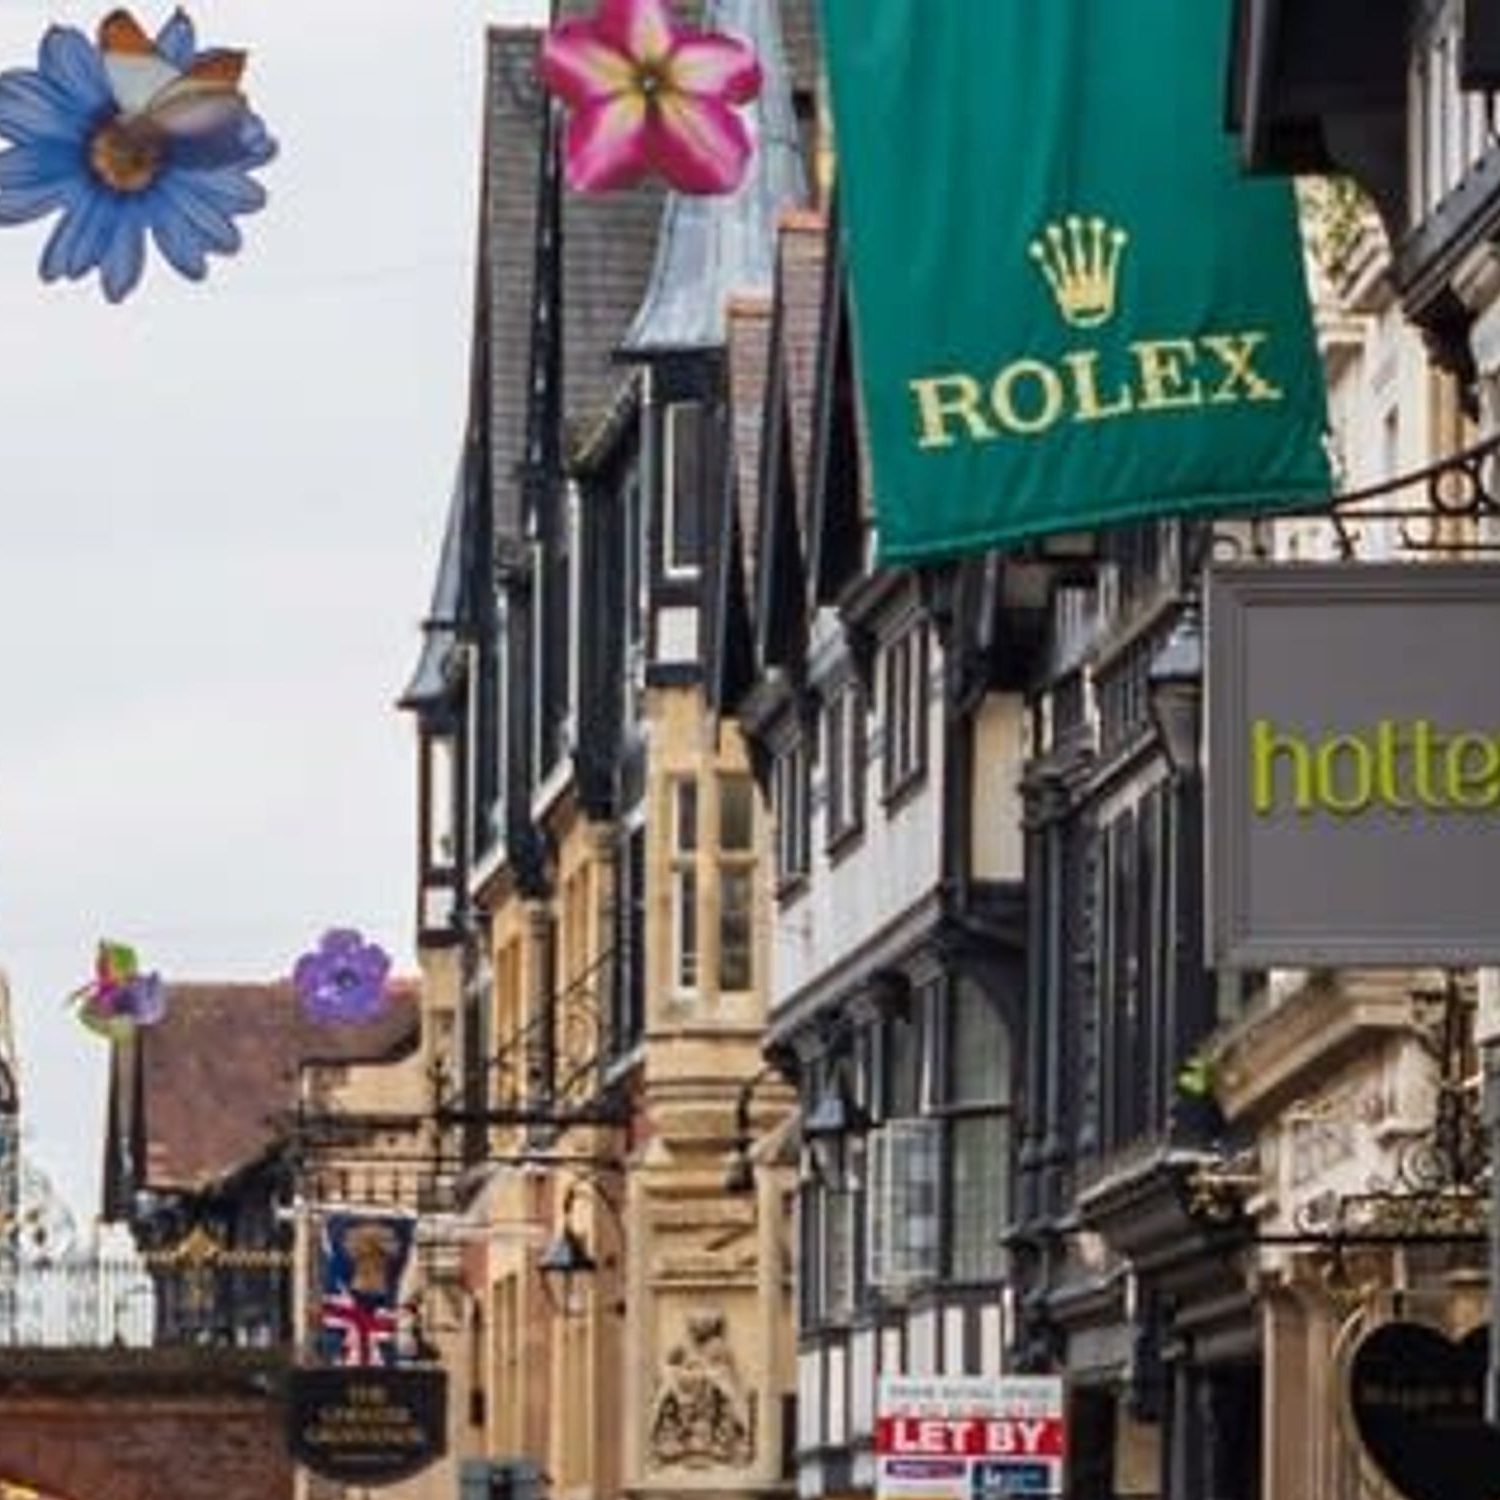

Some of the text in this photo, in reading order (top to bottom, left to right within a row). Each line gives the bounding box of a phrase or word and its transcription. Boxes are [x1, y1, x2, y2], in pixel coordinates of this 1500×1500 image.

[909, 332, 1283, 449] ROLEX
[894, 1420, 1046, 1452] LET BY
